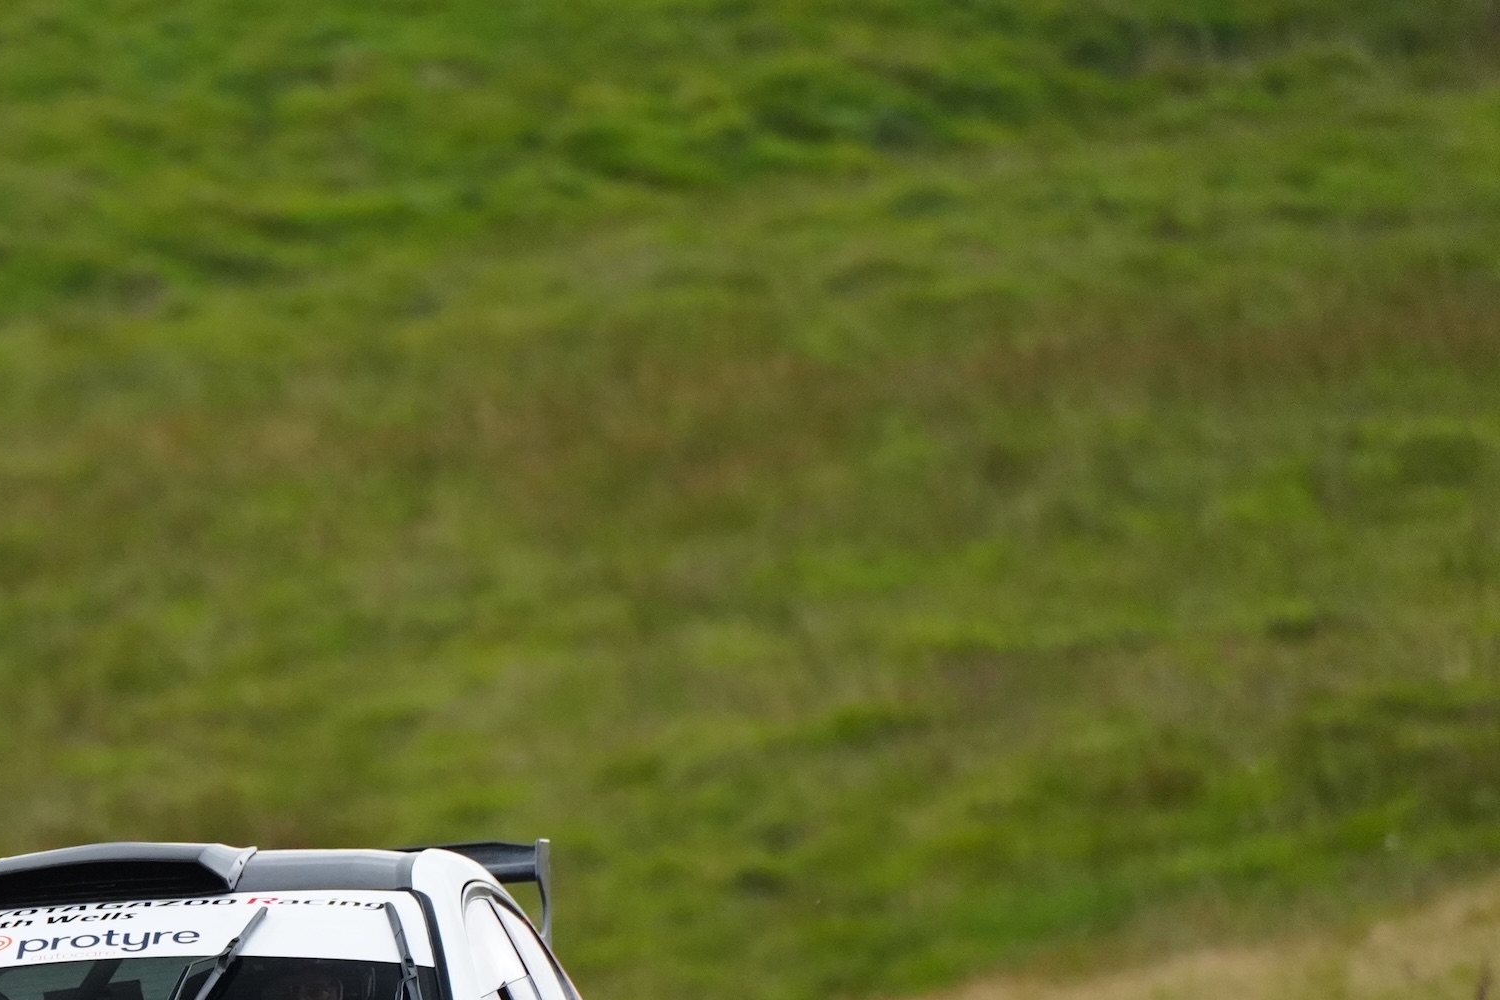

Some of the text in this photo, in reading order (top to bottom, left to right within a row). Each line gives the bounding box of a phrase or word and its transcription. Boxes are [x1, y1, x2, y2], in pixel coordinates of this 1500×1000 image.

[95, 899, 237, 910] GAZOO
[246, 897, 385, 911] Racing
[47, 912, 138, 925] Wells
[16, 929, 200, 960] protyre
[30, 950, 117, 962] autocare
